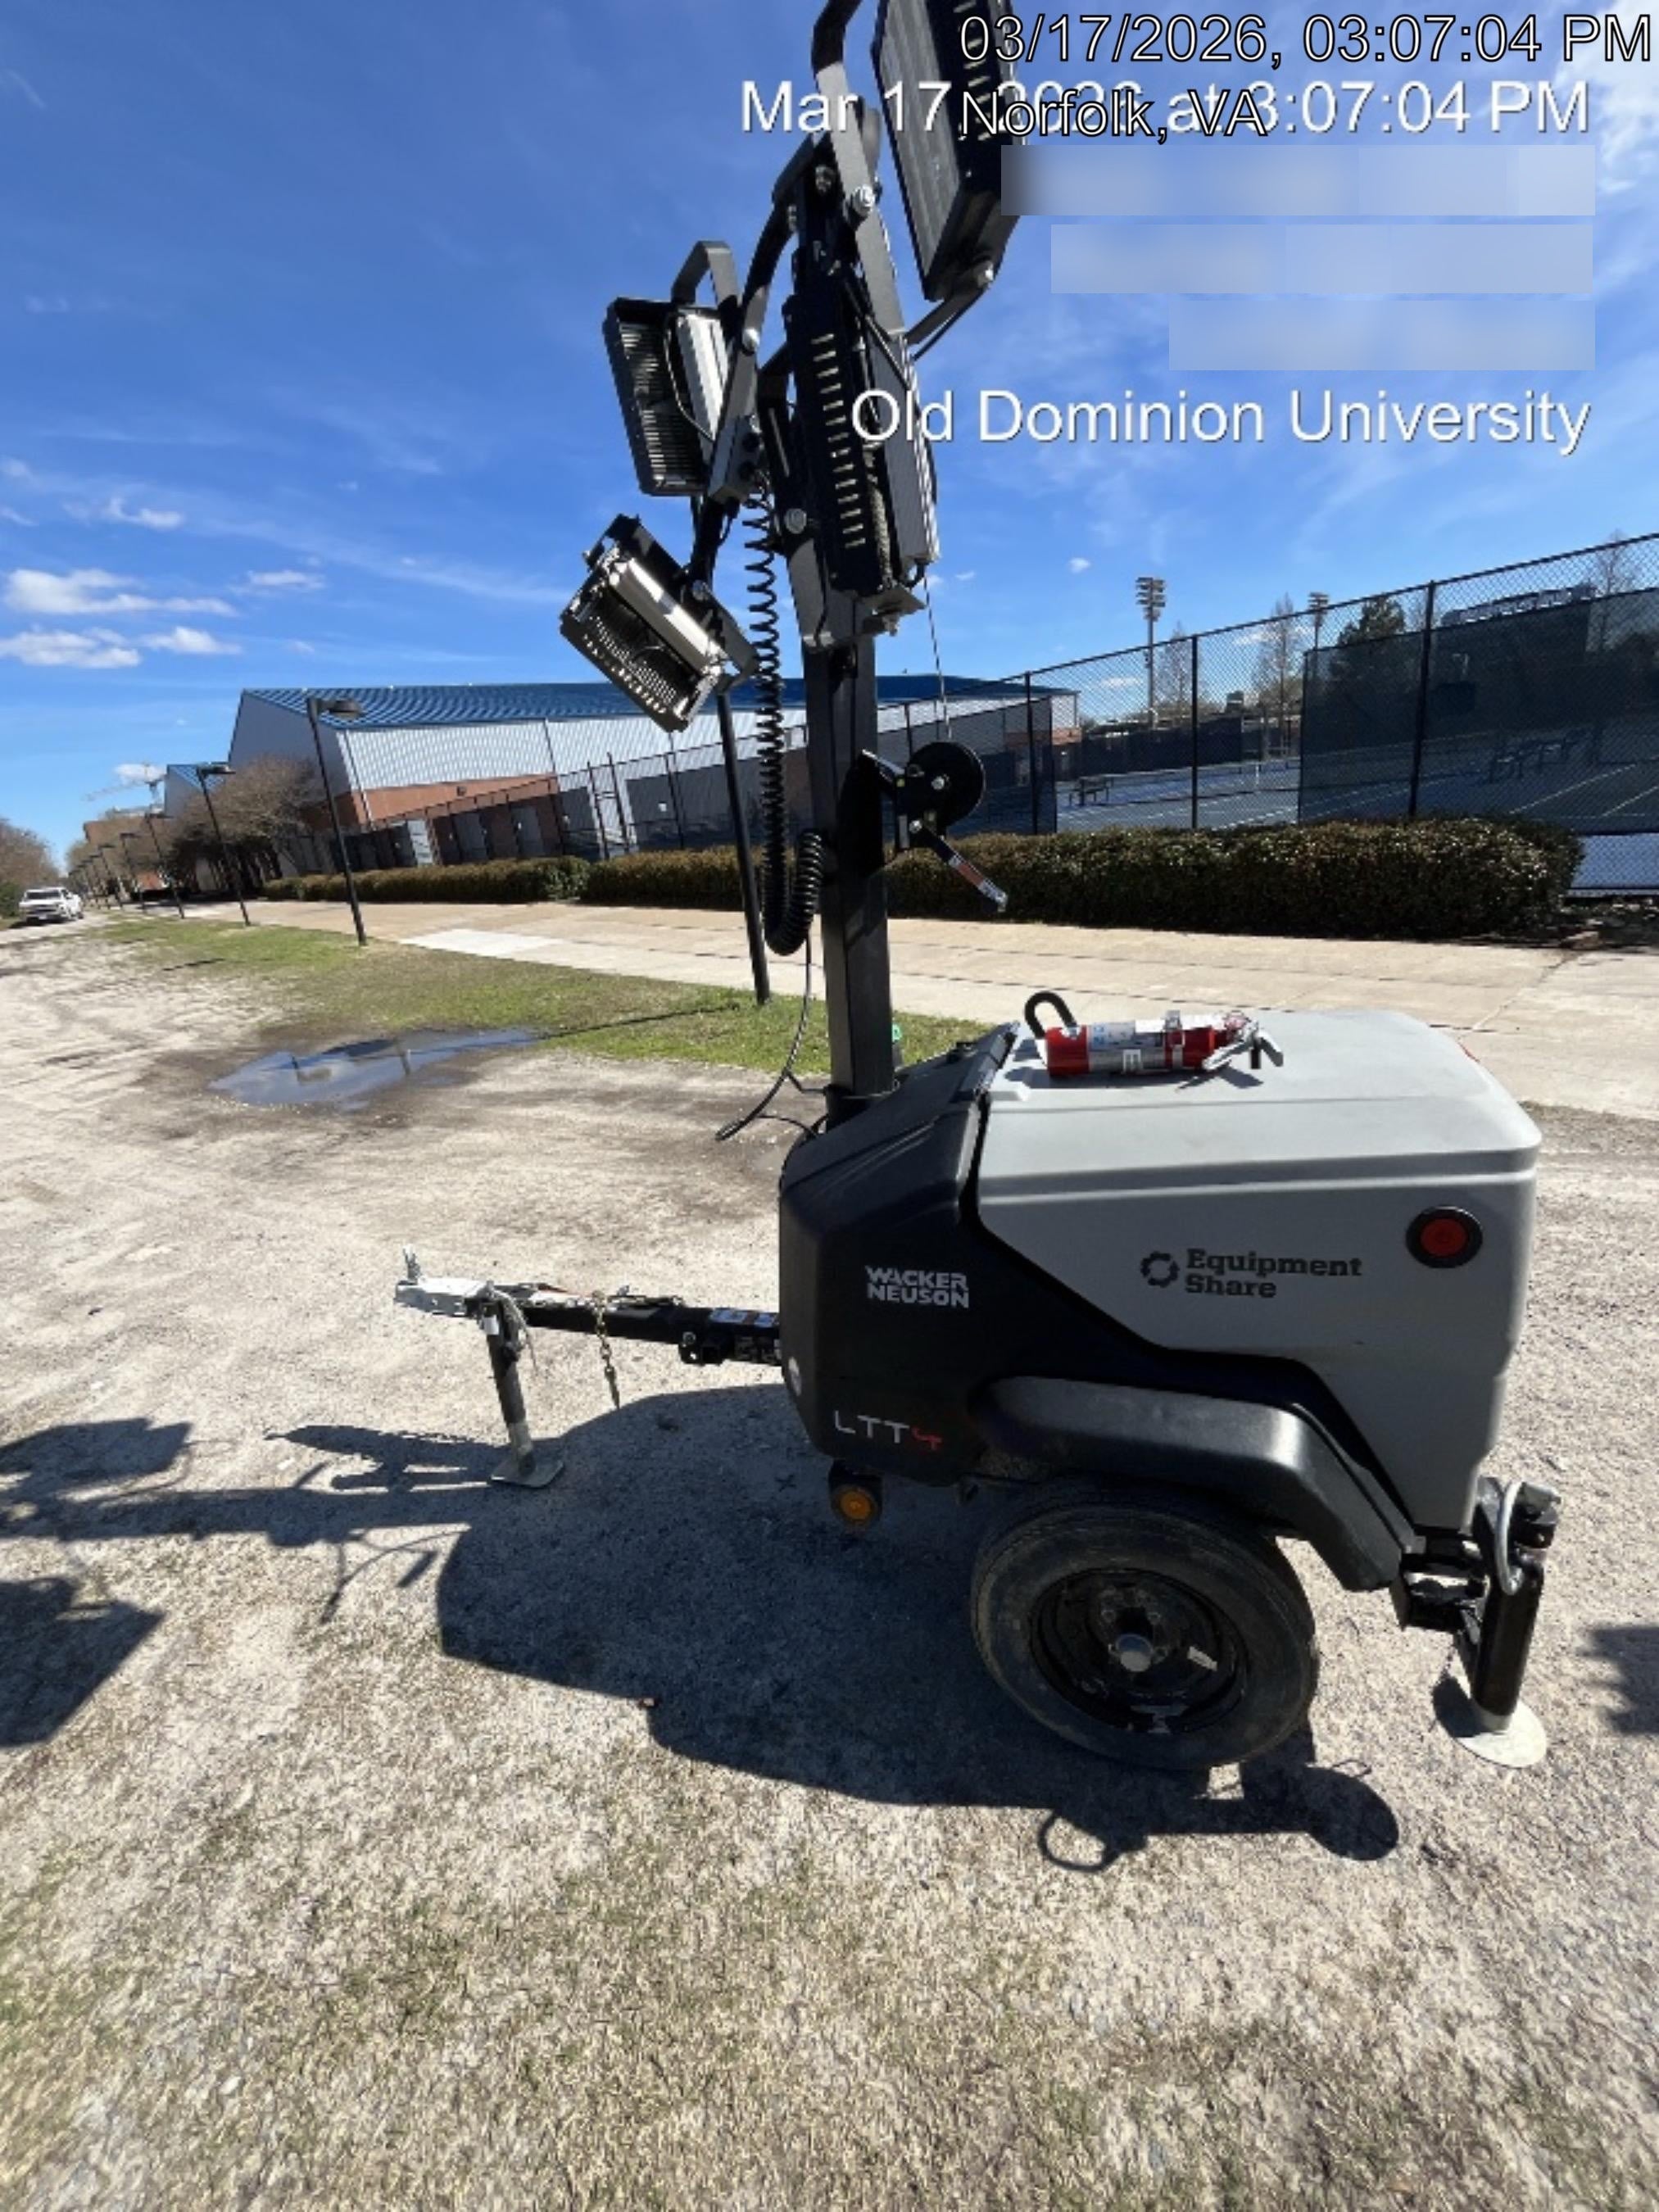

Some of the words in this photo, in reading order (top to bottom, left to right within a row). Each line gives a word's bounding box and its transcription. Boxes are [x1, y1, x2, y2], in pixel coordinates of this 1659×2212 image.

[1185, 1248, 1362, 1278] Equipment
[864, 1266, 969, 1291] WACKER
[1185, 1273, 1276, 1298] Share
[867, 1283, 969, 1308] NEUSON
[834, 1410, 942, 1450] LTT4
